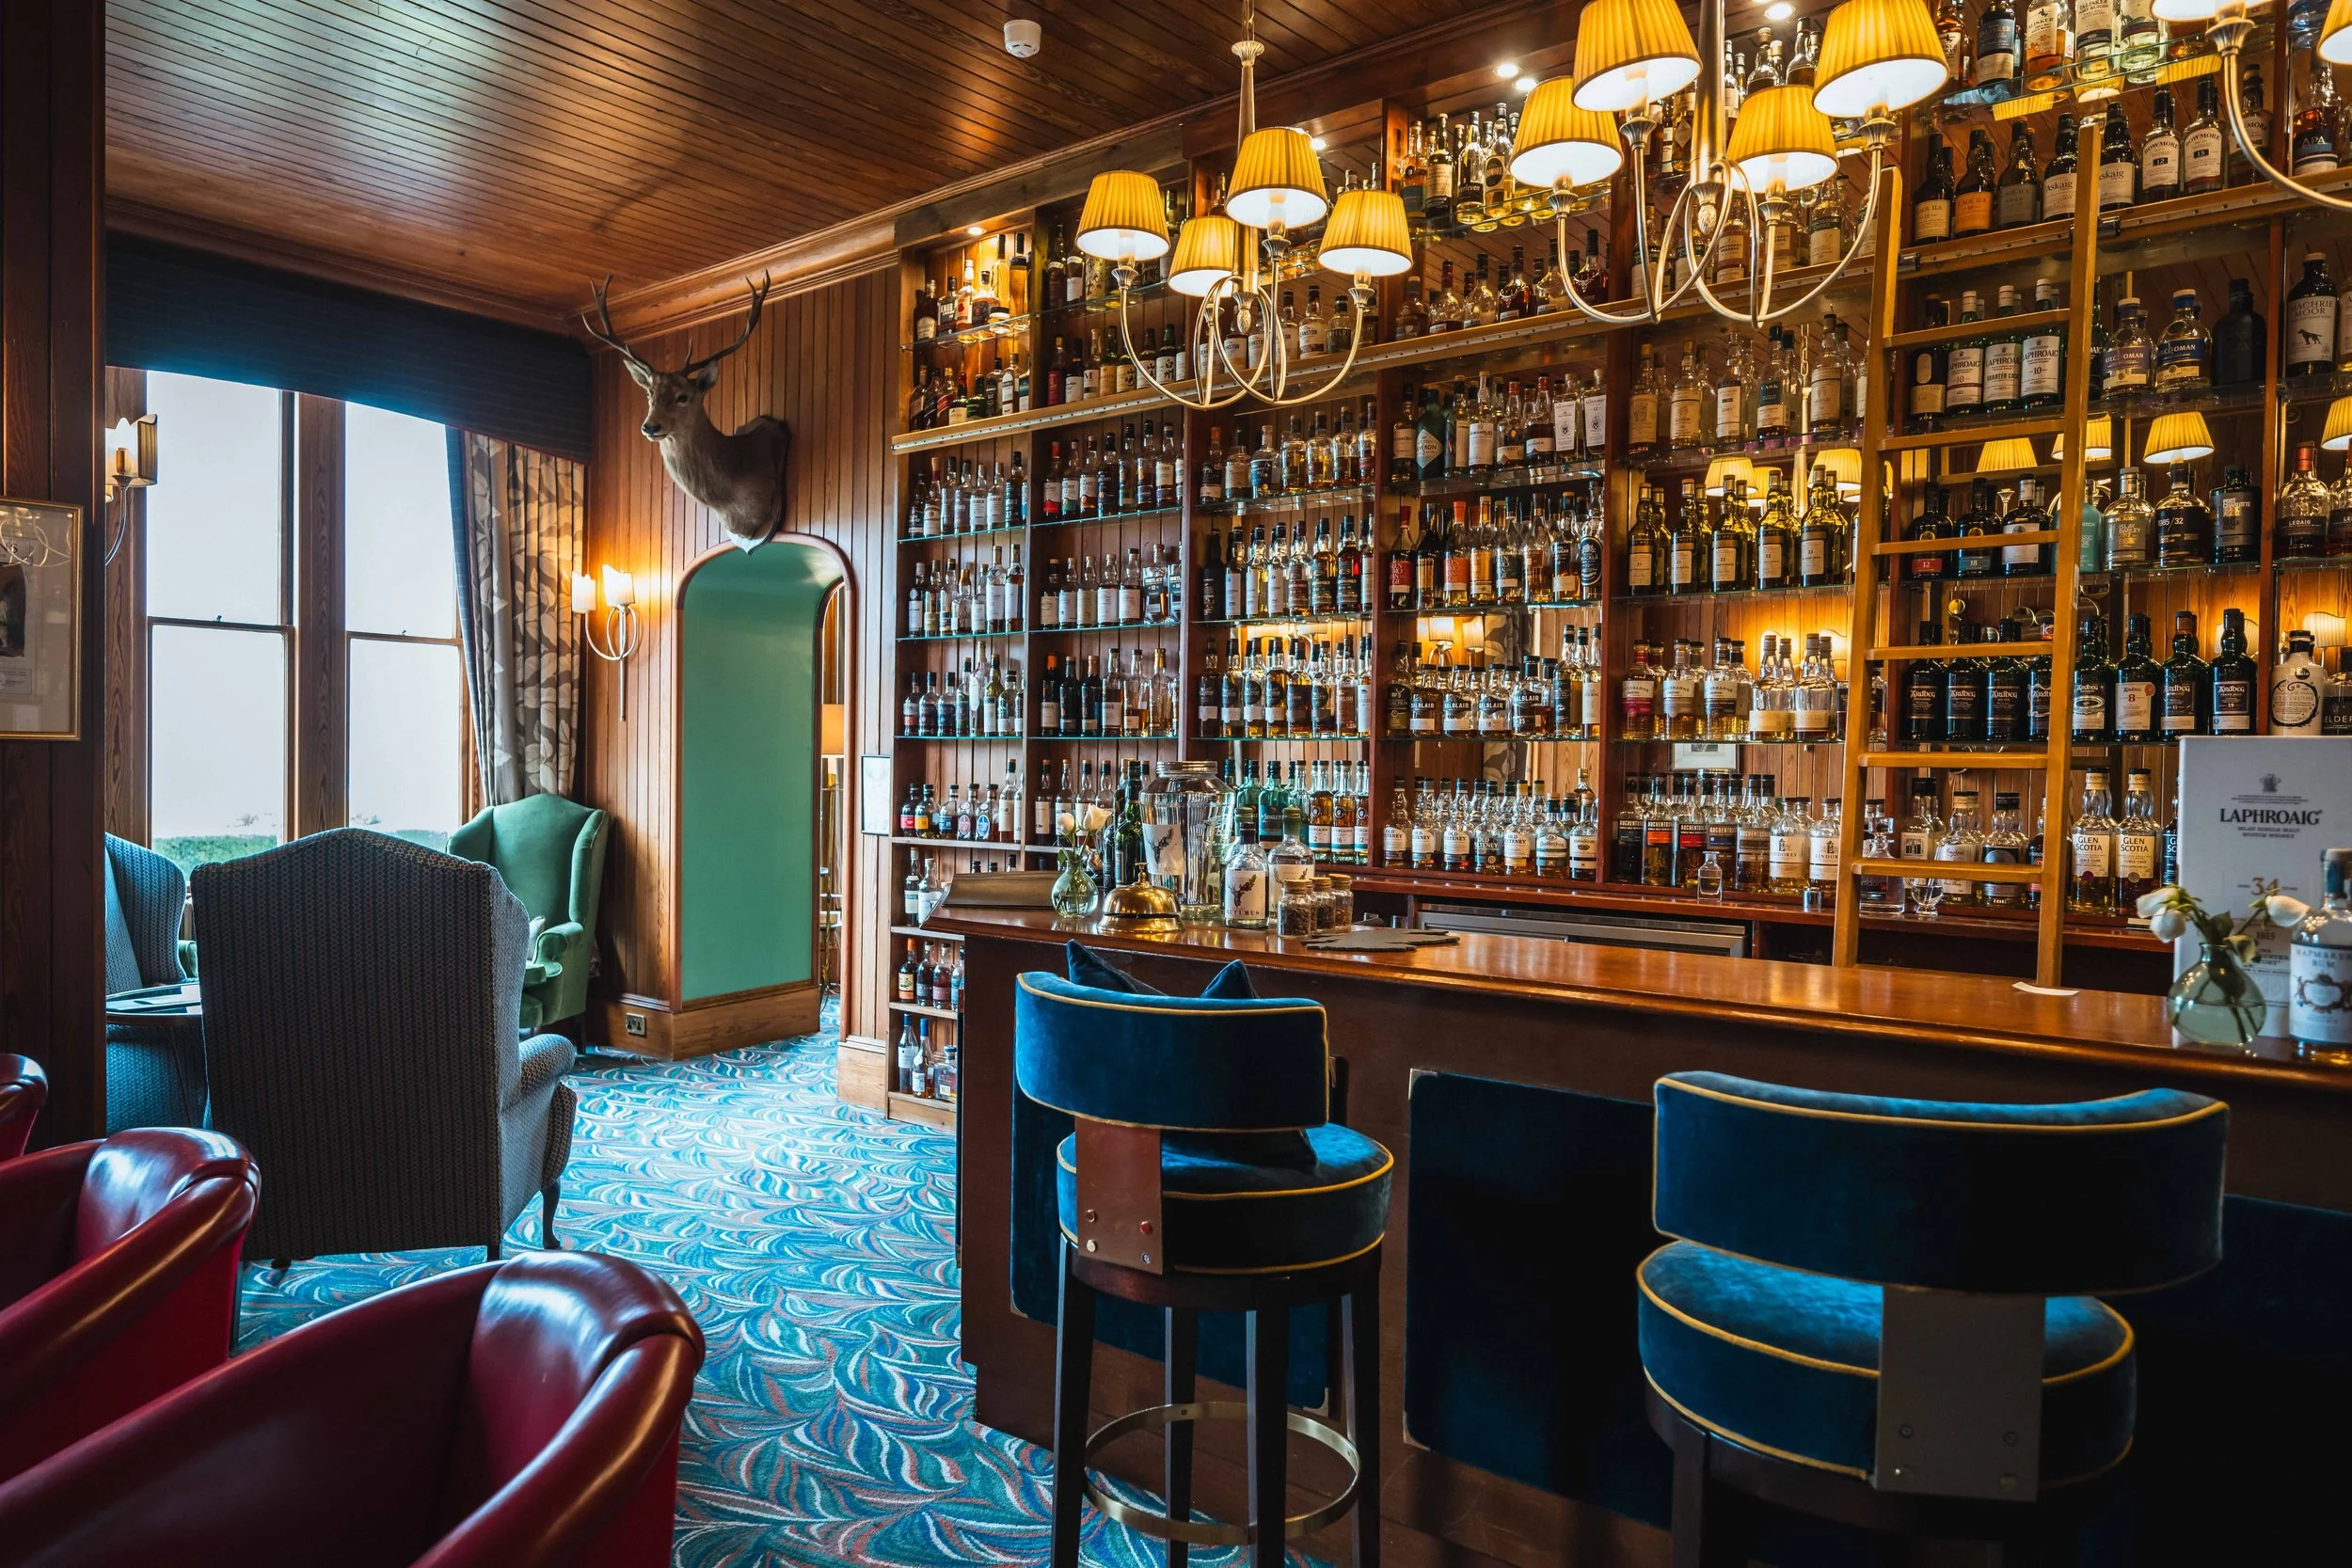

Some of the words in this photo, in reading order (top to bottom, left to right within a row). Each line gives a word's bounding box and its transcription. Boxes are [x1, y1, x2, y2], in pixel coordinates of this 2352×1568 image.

[2027, 17, 2054, 28] ALISKER
[2185, 133, 2221, 148] BOWMORE
[2144, 140, 2179, 154] BOWMORE
[2296, 307, 2326, 317] MOOR
[1948, 360, 1981, 370] APHROAIG
[2033, 367, 2042, 375] 10
[1956, 375, 1964, 384] 10
[2128, 693, 2136, 703] 8
[2219, 808, 2321, 826] LAPHROAIG
[2123, 836, 2145, 845] GLEN
[2075, 843, 2103, 851] SCOTIA
[2121, 844, 2149, 852] SCOTIA
[2250, 877, 2280, 896] 34
[2312, 959, 2335, 969] RUM
